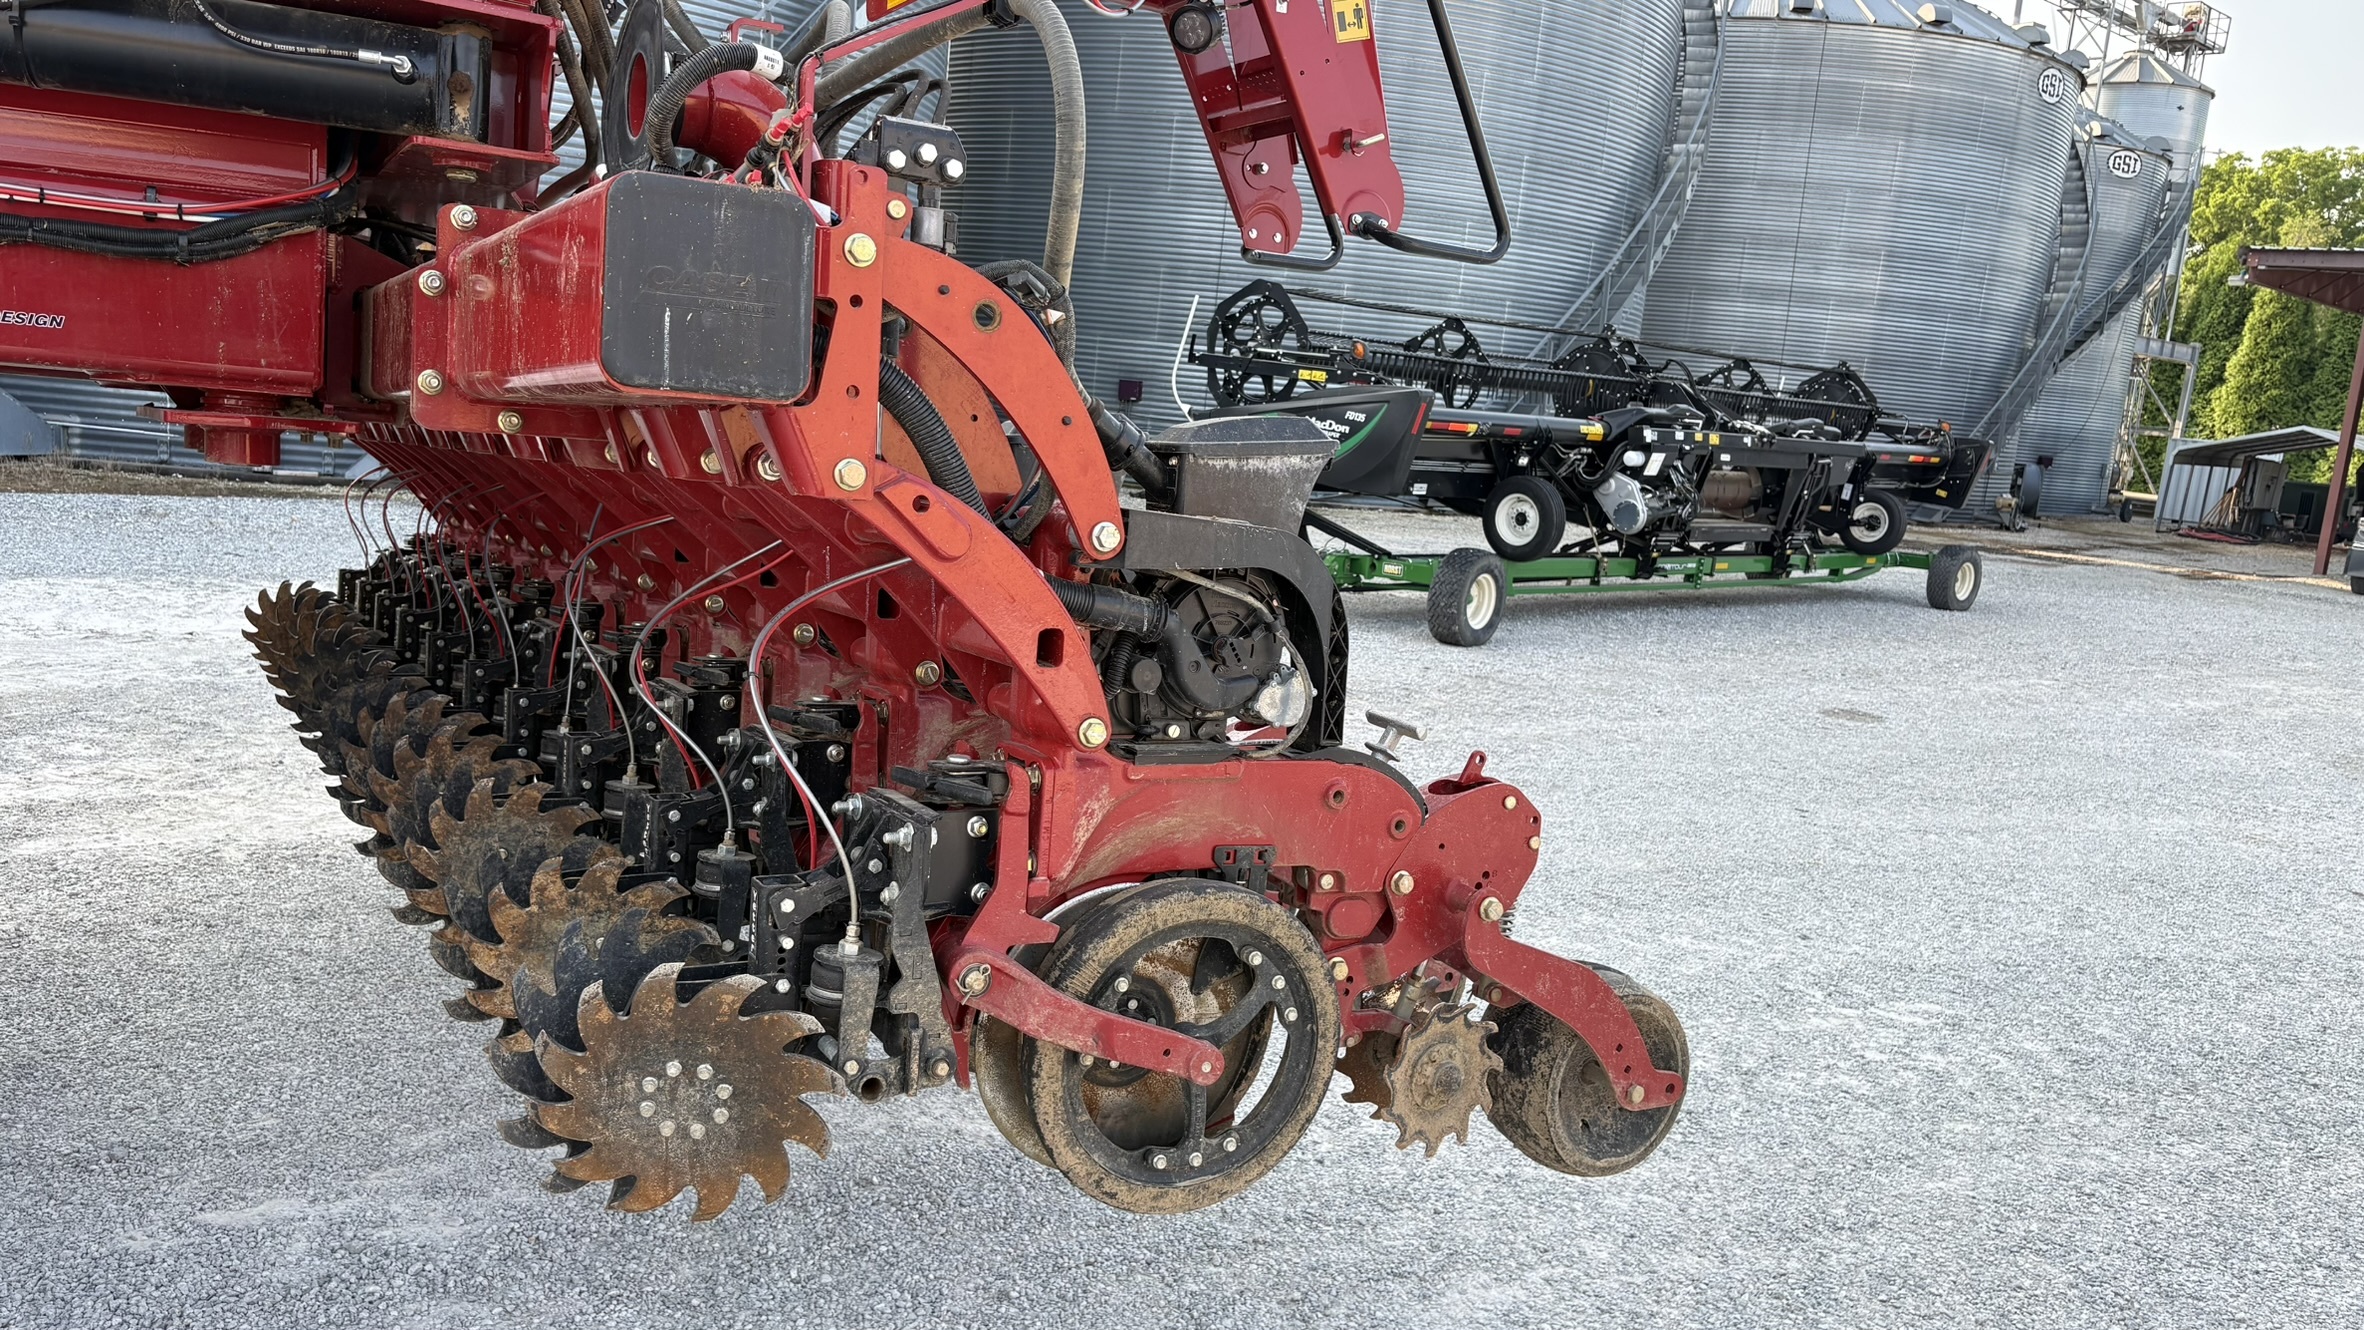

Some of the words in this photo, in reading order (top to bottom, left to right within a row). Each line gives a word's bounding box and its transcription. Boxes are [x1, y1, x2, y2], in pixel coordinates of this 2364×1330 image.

[275, 43, 295, 51] EXCEEDS
[2041, 74, 2062, 98] GSI
[2112, 154, 2138, 174] GSI
[0, 310, 66, 329] ESIGN
[1345, 411, 1366, 422] FD135
